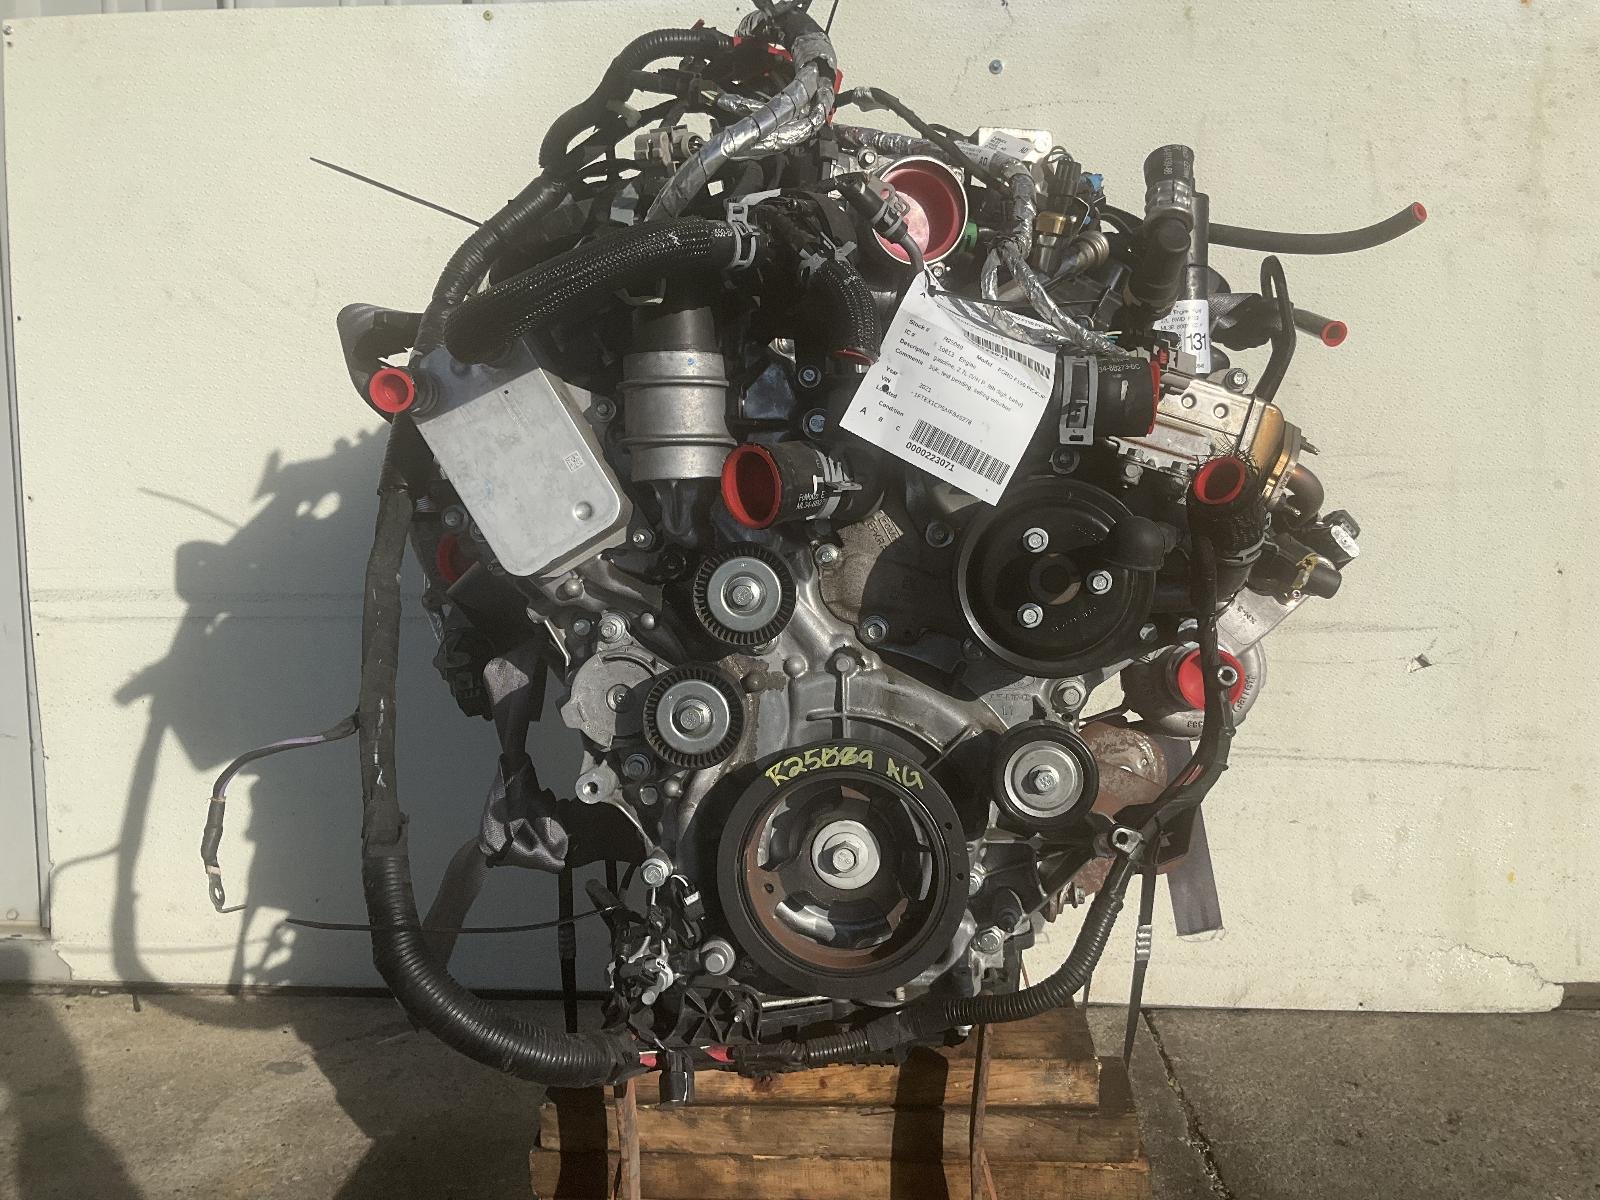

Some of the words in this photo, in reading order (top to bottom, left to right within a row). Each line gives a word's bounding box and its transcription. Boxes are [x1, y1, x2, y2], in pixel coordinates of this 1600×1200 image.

[1186, 332, 1207, 350] 131
[877, 400, 904, 417] Condition
[905, 441, 955, 472] 0000223071
